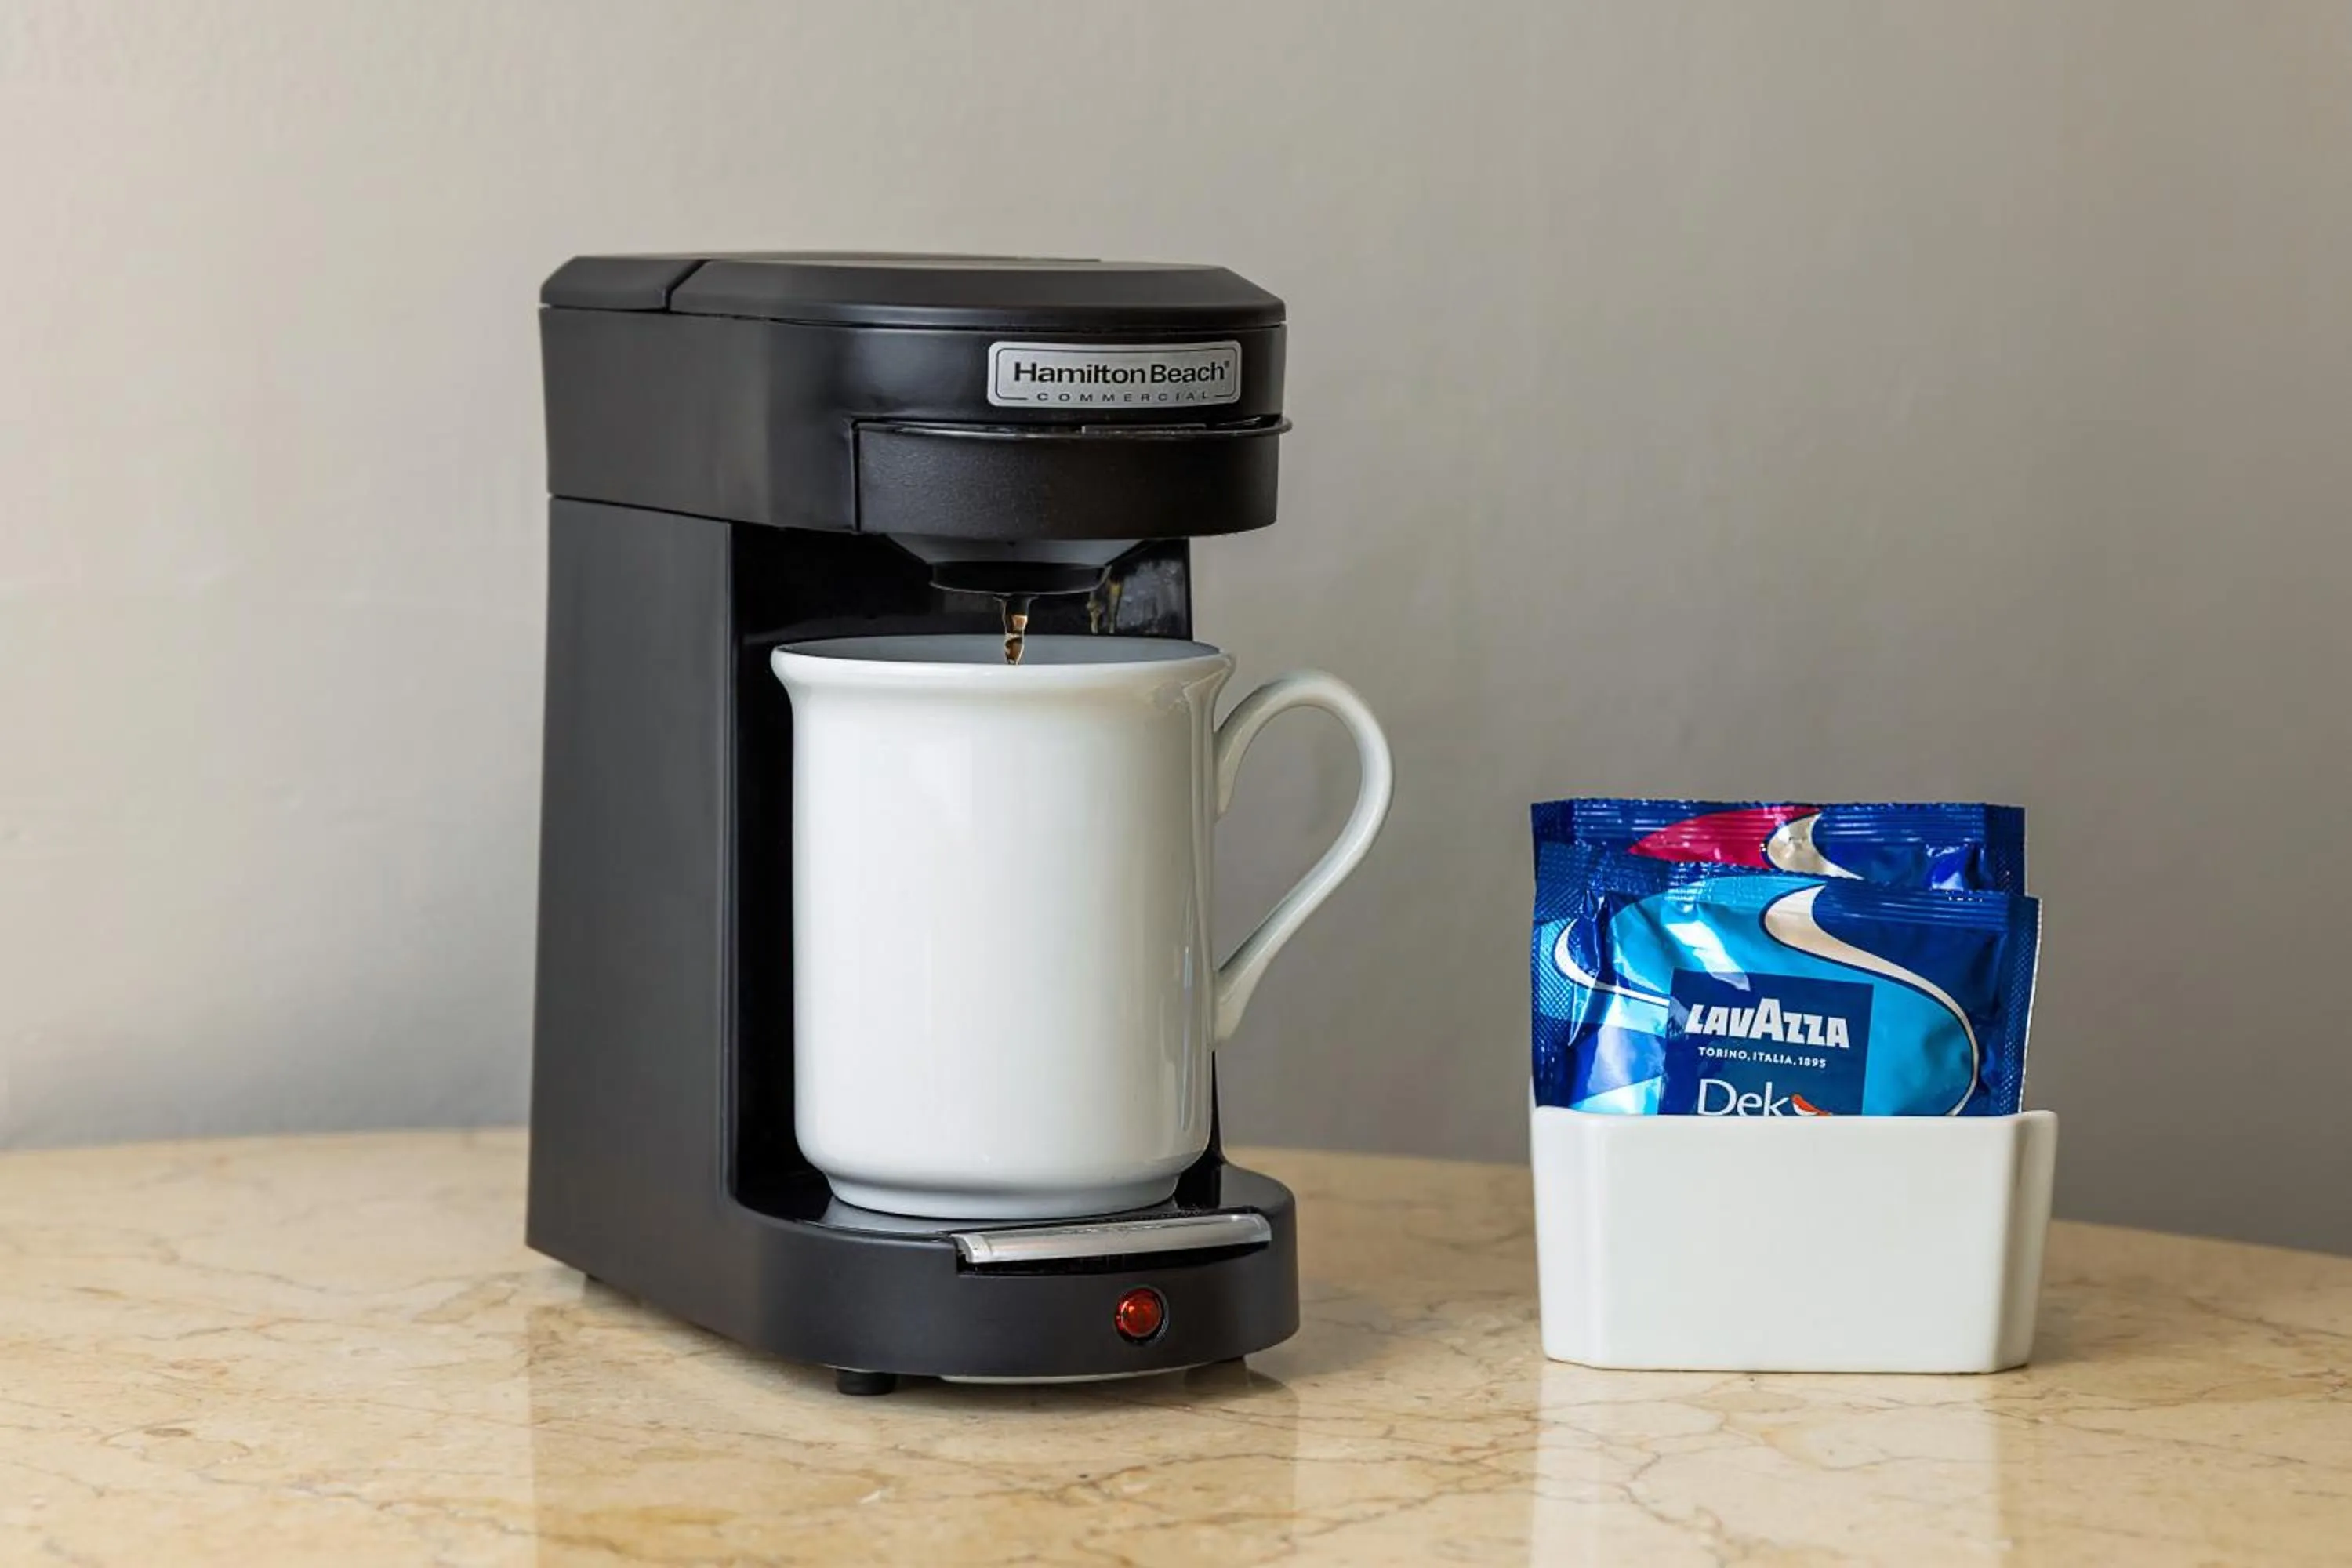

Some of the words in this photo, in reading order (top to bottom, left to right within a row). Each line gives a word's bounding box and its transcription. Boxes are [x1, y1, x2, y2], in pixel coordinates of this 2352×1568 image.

[1014, 362, 1145, 383] Hamilton
[1150, 361, 1224, 383] Beach
[1037, 392, 1208, 402] COMMERCIAL
[1685, 997, 1849, 1048] LAVAZZA
[1798, 1056, 1827, 1069] 1895
[1697, 1078, 1790, 1116] Dek
